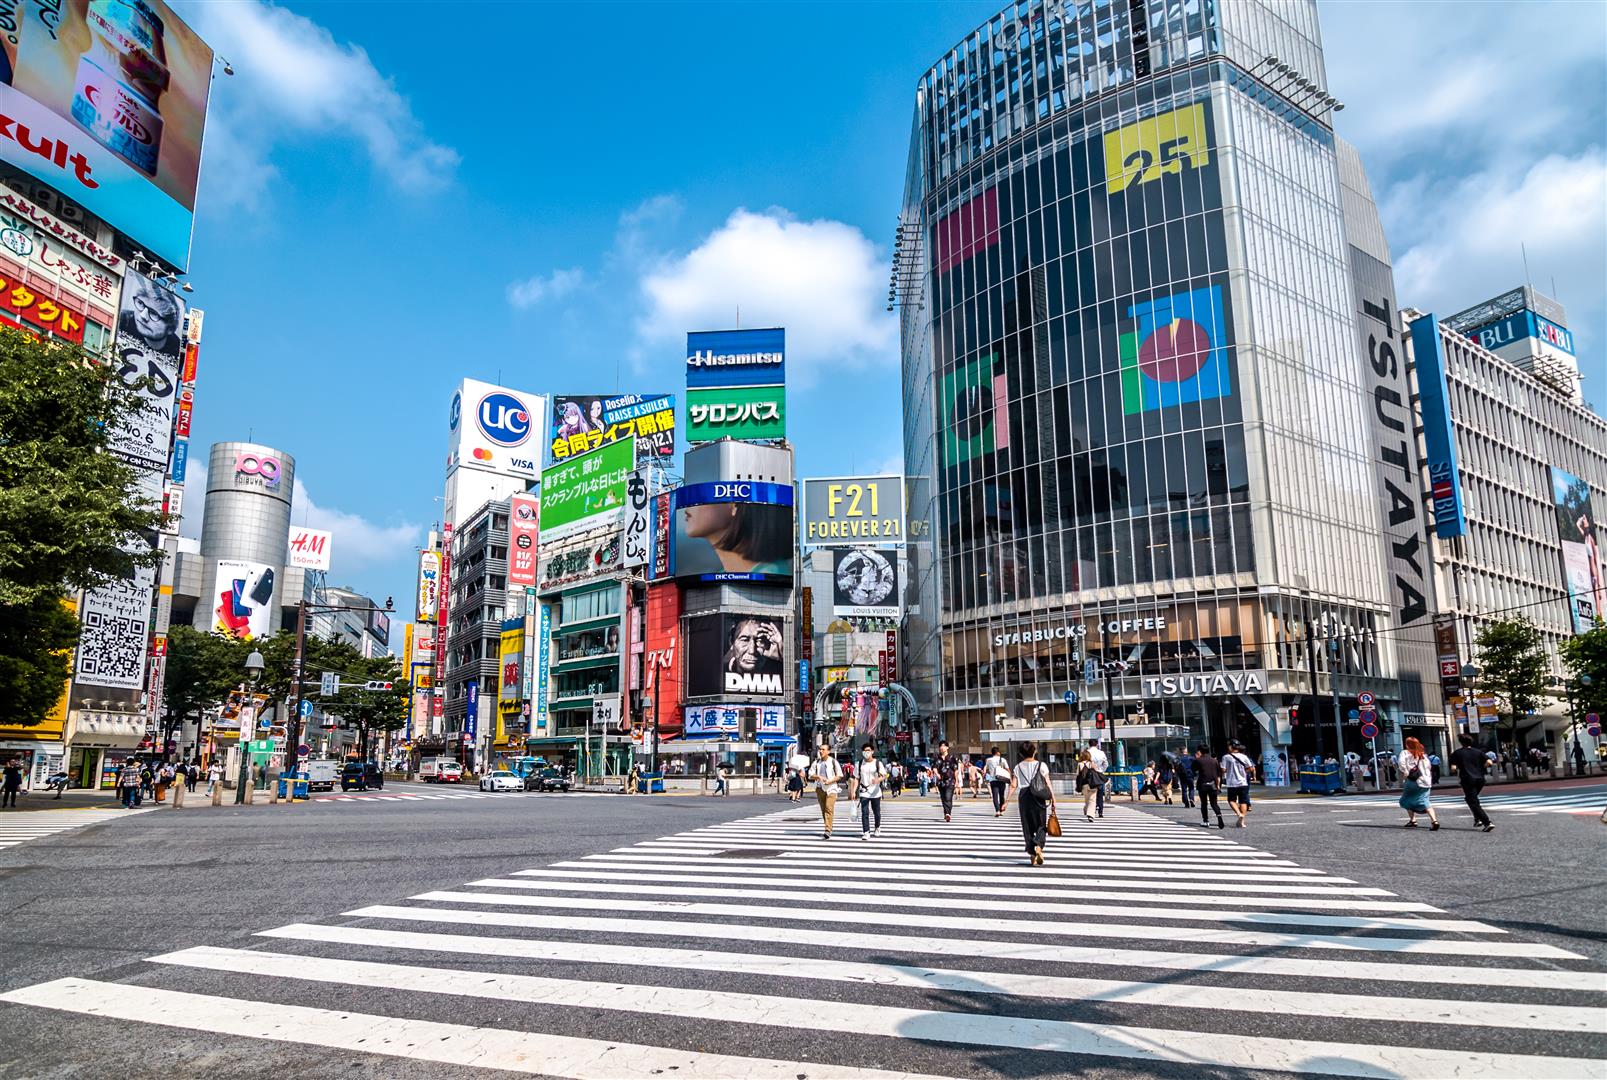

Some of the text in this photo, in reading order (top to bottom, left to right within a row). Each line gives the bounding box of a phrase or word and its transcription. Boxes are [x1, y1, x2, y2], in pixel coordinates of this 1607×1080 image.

[1123, 135, 1193, 189] 25
[0, 194, 120, 266] ゃぶしゃぶバイキング
[40, 242, 113, 298] しゃぶ葉
[0, 279, 79, 333] タクト
[687, 350, 783, 367] Hisamitsu
[482, 402, 527, 434] UC
[605, 396, 635, 411] Roselia
[608, 399, 670, 423] RAISE A SUILEN
[690, 402, 780, 424] サロンパス
[552, 409, 675, 458] 合同ライブ開催
[233, 453, 282, 488] 109
[510, 457, 535, 470] VISA
[543, 455, 603, 491] 暑すぎて、頭が
[1363, 297, 1427, 625] TSUTAYA
[543, 467, 628, 509] スクランブルな日には
[714, 484, 751, 498] DHC
[828, 483, 878, 518] F21
[1430, 462, 1457, 526] SEIBU
[626, 471, 648, 562] もんじゃ
[808, 518, 900, 538] FOREVER 21
[291, 533, 326, 555] H&M
[994, 616, 1166, 647] STARBUCKS COFFEE
[725, 671, 783, 694] DMM
[1145, 672, 1263, 695] TSUTAYA
[690, 709, 779, 728] 大盛堂店
